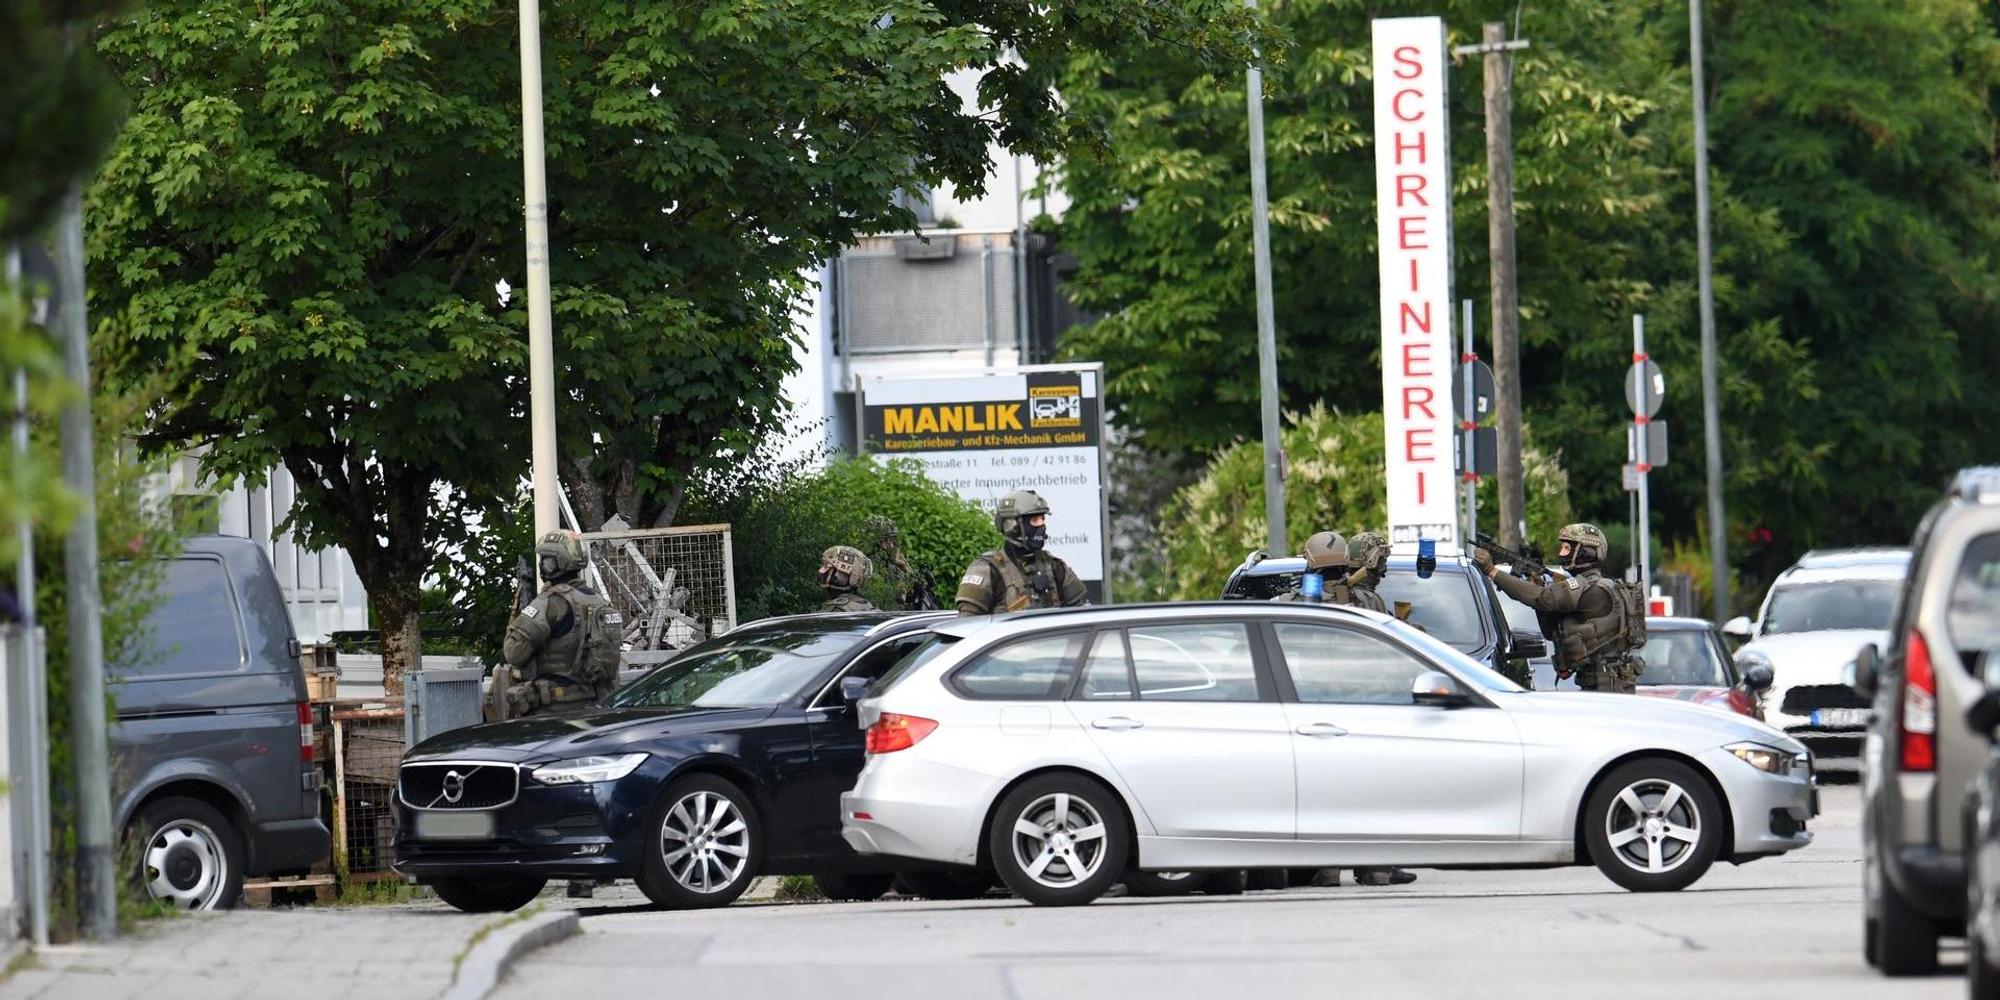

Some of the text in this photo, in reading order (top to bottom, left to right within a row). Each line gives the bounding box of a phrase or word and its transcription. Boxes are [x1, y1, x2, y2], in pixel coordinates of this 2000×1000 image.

[1392, 45, 1436, 505] SCHREINEREI
[884, 403, 1023, 435] MANLIK
[962, 435, 982, 447] und
[984, 432, 1052, 446] Kfz-Mechanik
[1054, 431, 1086, 444] GmbH
[967, 459, 978, 467] 11
[1010, 456, 1030, 465] 089
[1042, 455, 1055, 464] 42
[1058, 455, 1070, 464] 91
[1074, 455, 1087, 464] 86
[974, 473, 1088, 489] Innungsfachbetrieb
[1047, 533, 1089, 544] technik
